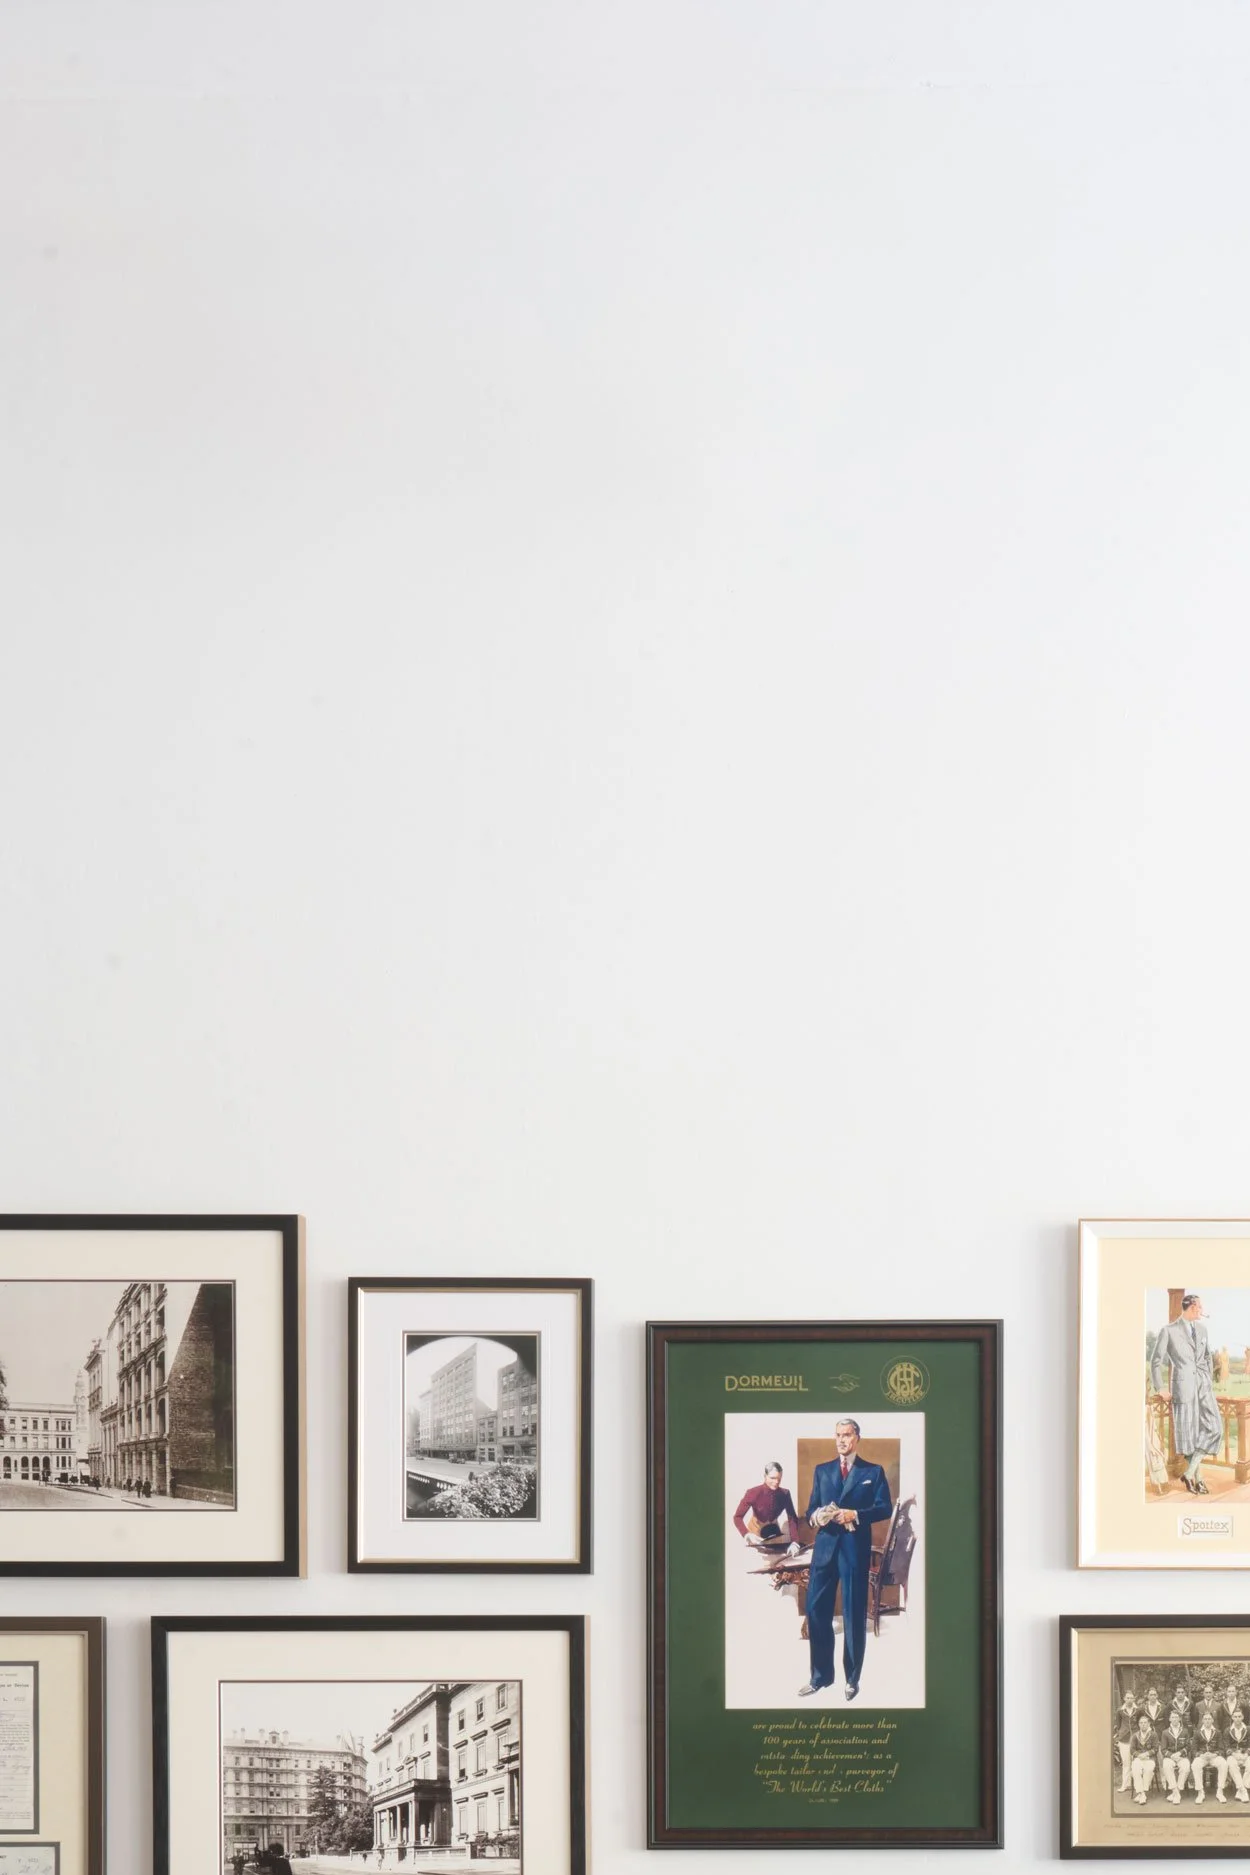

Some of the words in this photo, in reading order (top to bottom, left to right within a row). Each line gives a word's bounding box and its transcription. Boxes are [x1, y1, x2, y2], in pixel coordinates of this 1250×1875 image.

[725, 1375, 809, 1392] DORMEUIL
[1182, 1518, 1230, 1536] Sportex
[752, 1722, 766, 1730] are
[768, 1717, 797, 1733] proud
[798, 1720, 807, 1730] to
[809, 1715, 850, 1730] celebrate
[877, 1716, 898, 1730] than
[763, 1735, 780, 1745] 100
[782, 1737, 806, 1748] years
[808, 1732, 820, 1748] of
[820, 1734, 869, 1745] association
[871, 1732, 891, 1745] and
[754, 1763, 788, 1779] bespoke
[790, 1762, 815, 1776] tailor
[845, 1768, 886, 1779] purveyor
[887, 1762, 901, 1779] of
[829, 1780, 851, 1794] Best
